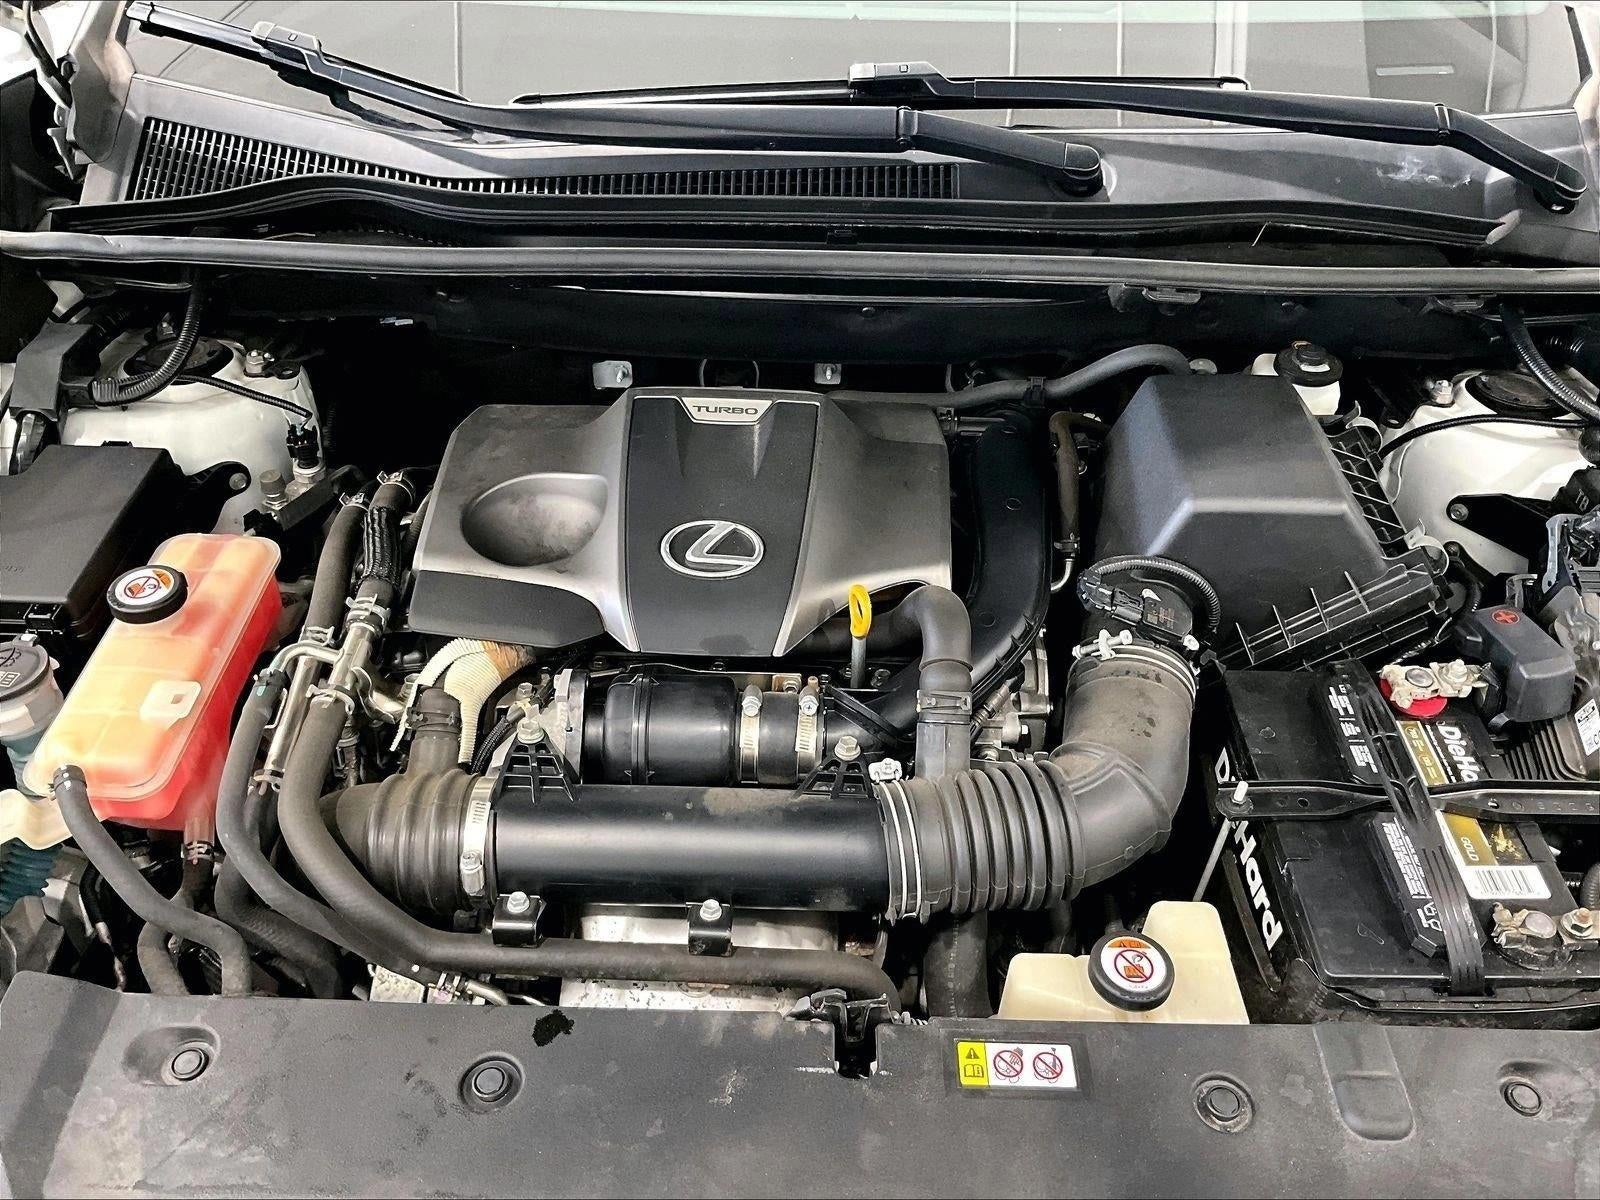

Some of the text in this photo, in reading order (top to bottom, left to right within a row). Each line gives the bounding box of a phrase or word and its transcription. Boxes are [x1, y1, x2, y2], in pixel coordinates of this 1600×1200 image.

[693, 405, 759, 415] TURBO
[1436, 724, 1480, 783] DieHa
[1214, 747, 1284, 951] DHard
[1460, 836, 1480, 861] GOLD
